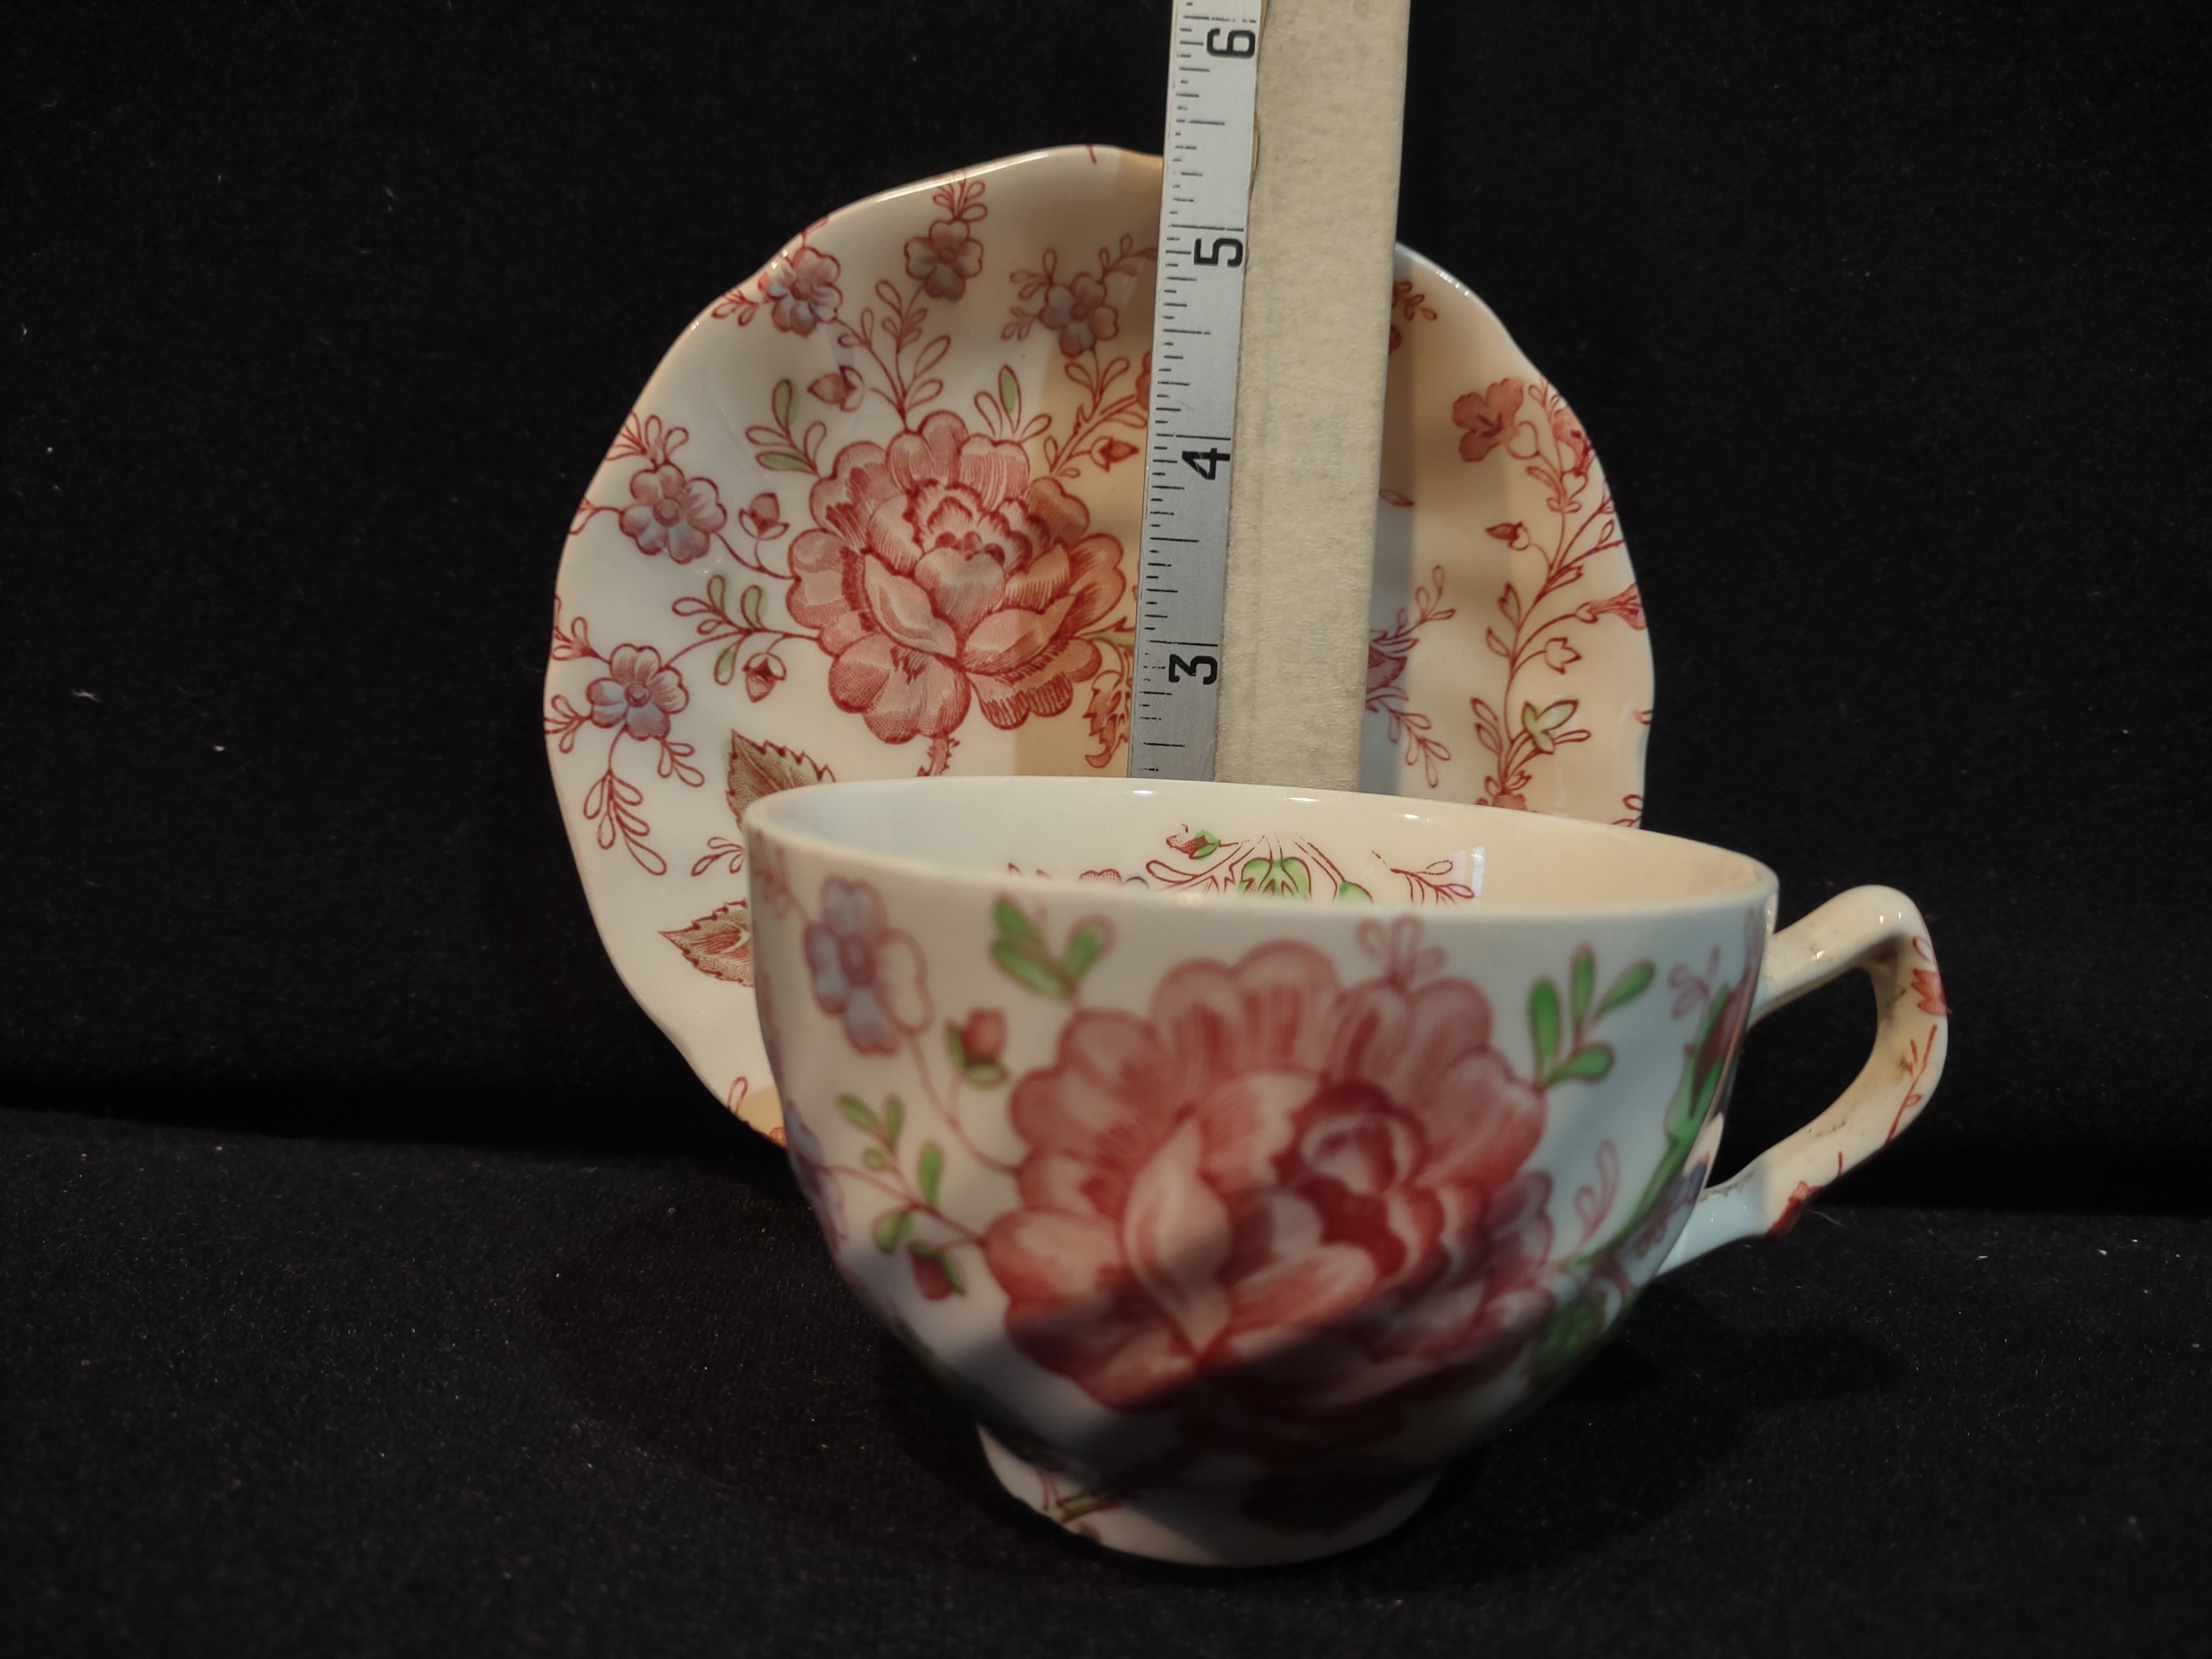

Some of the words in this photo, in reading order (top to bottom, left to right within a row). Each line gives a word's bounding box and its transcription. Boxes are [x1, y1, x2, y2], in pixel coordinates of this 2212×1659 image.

[1206, 28, 1256, 59] 6
[1194, 238, 1243, 268] 5
[1181, 448, 1230, 480] 4
[1168, 653, 1218, 685] 3
